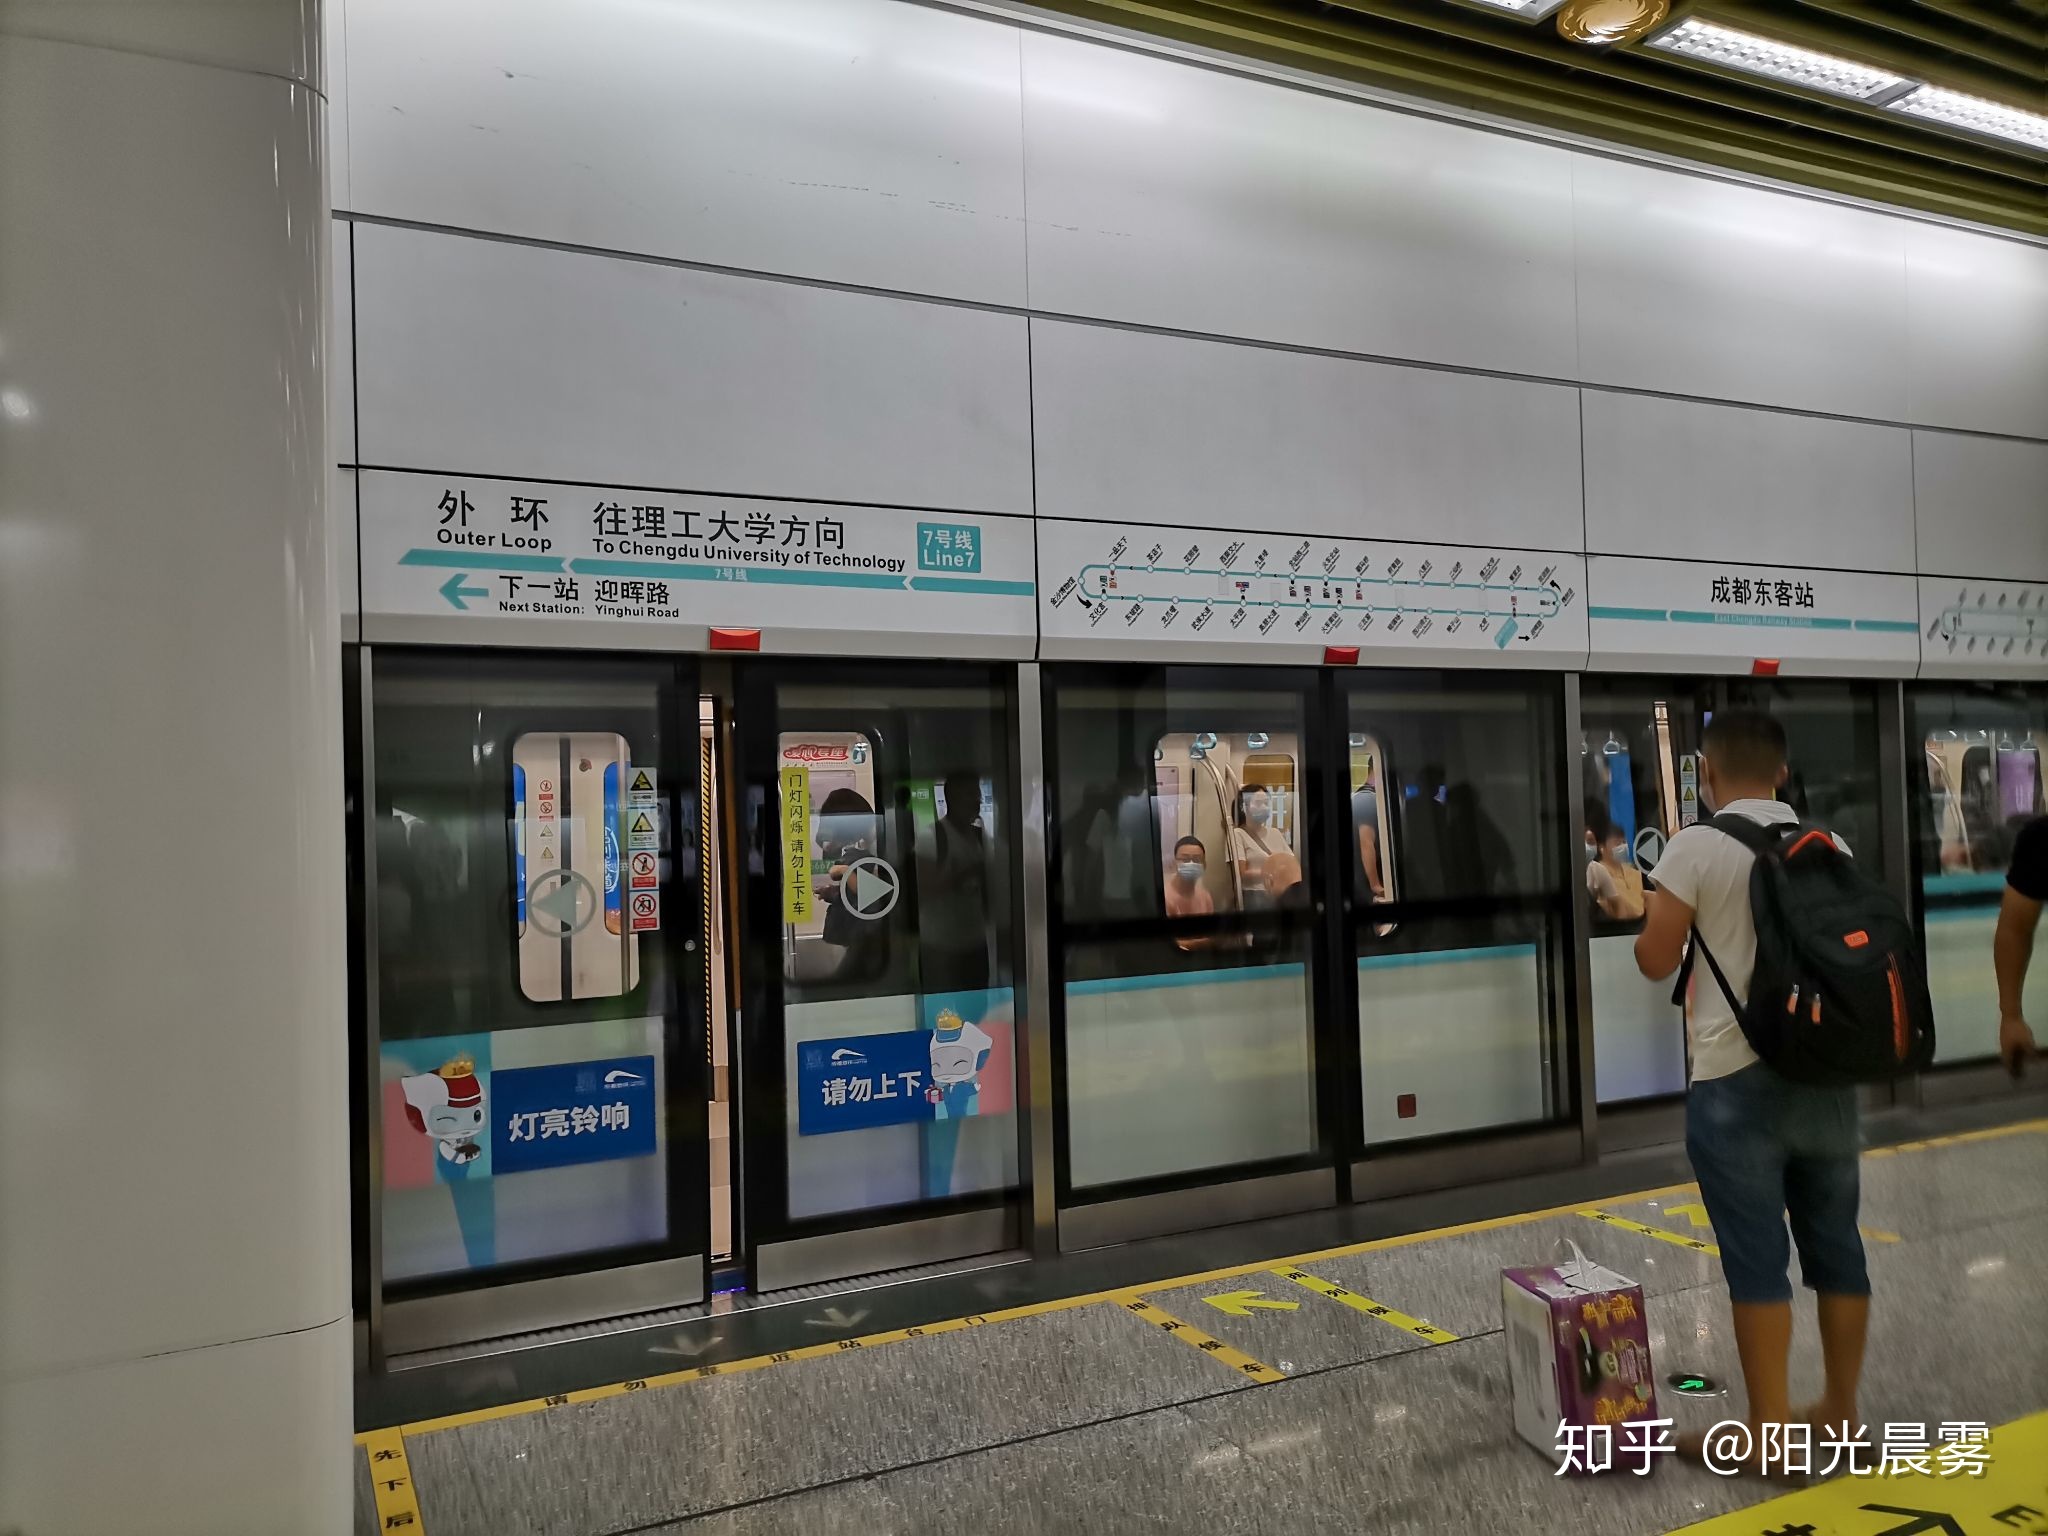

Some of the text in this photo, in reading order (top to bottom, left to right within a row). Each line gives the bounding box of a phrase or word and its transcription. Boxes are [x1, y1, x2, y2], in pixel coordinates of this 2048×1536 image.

[437, 489, 844, 550] 外环 往理工大学方向
[437, 529, 906, 573] Outer Loop To Chengdu University of Technology
[922, 529, 974, 551] 7号线
[715, 568, 748, 581] 7号线
[923, 549, 975, 568] Line7
[499, 575, 670, 606] 下一站 迎晖路
[1710, 576, 1814, 608] 成都东客站
[499, 601, 679, 618] Next Station: Yinghui Road
[822, 1070, 922, 1106] 请勿上下
[508, 1101, 630, 1143] 灯亮铃响
[1127, 1302, 1265, 1373] 排队候车
